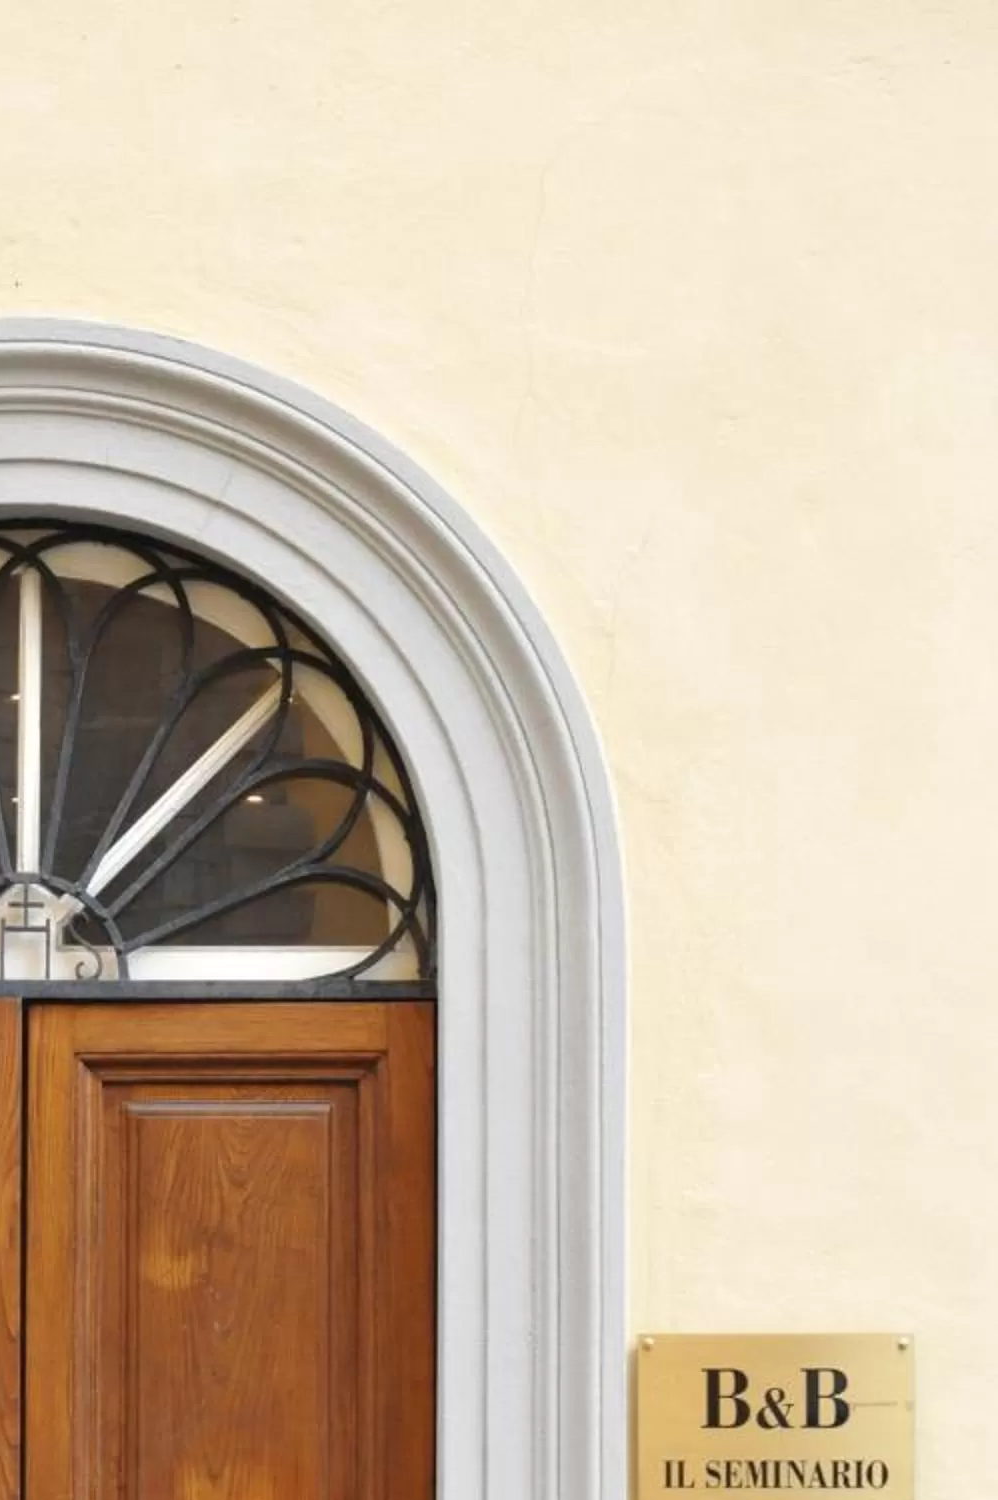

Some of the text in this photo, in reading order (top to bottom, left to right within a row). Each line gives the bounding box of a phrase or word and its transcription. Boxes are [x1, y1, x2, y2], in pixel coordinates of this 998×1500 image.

[701, 1368, 851, 1429] B&B
[663, 1459, 889, 1489] IL SEMINARIO
